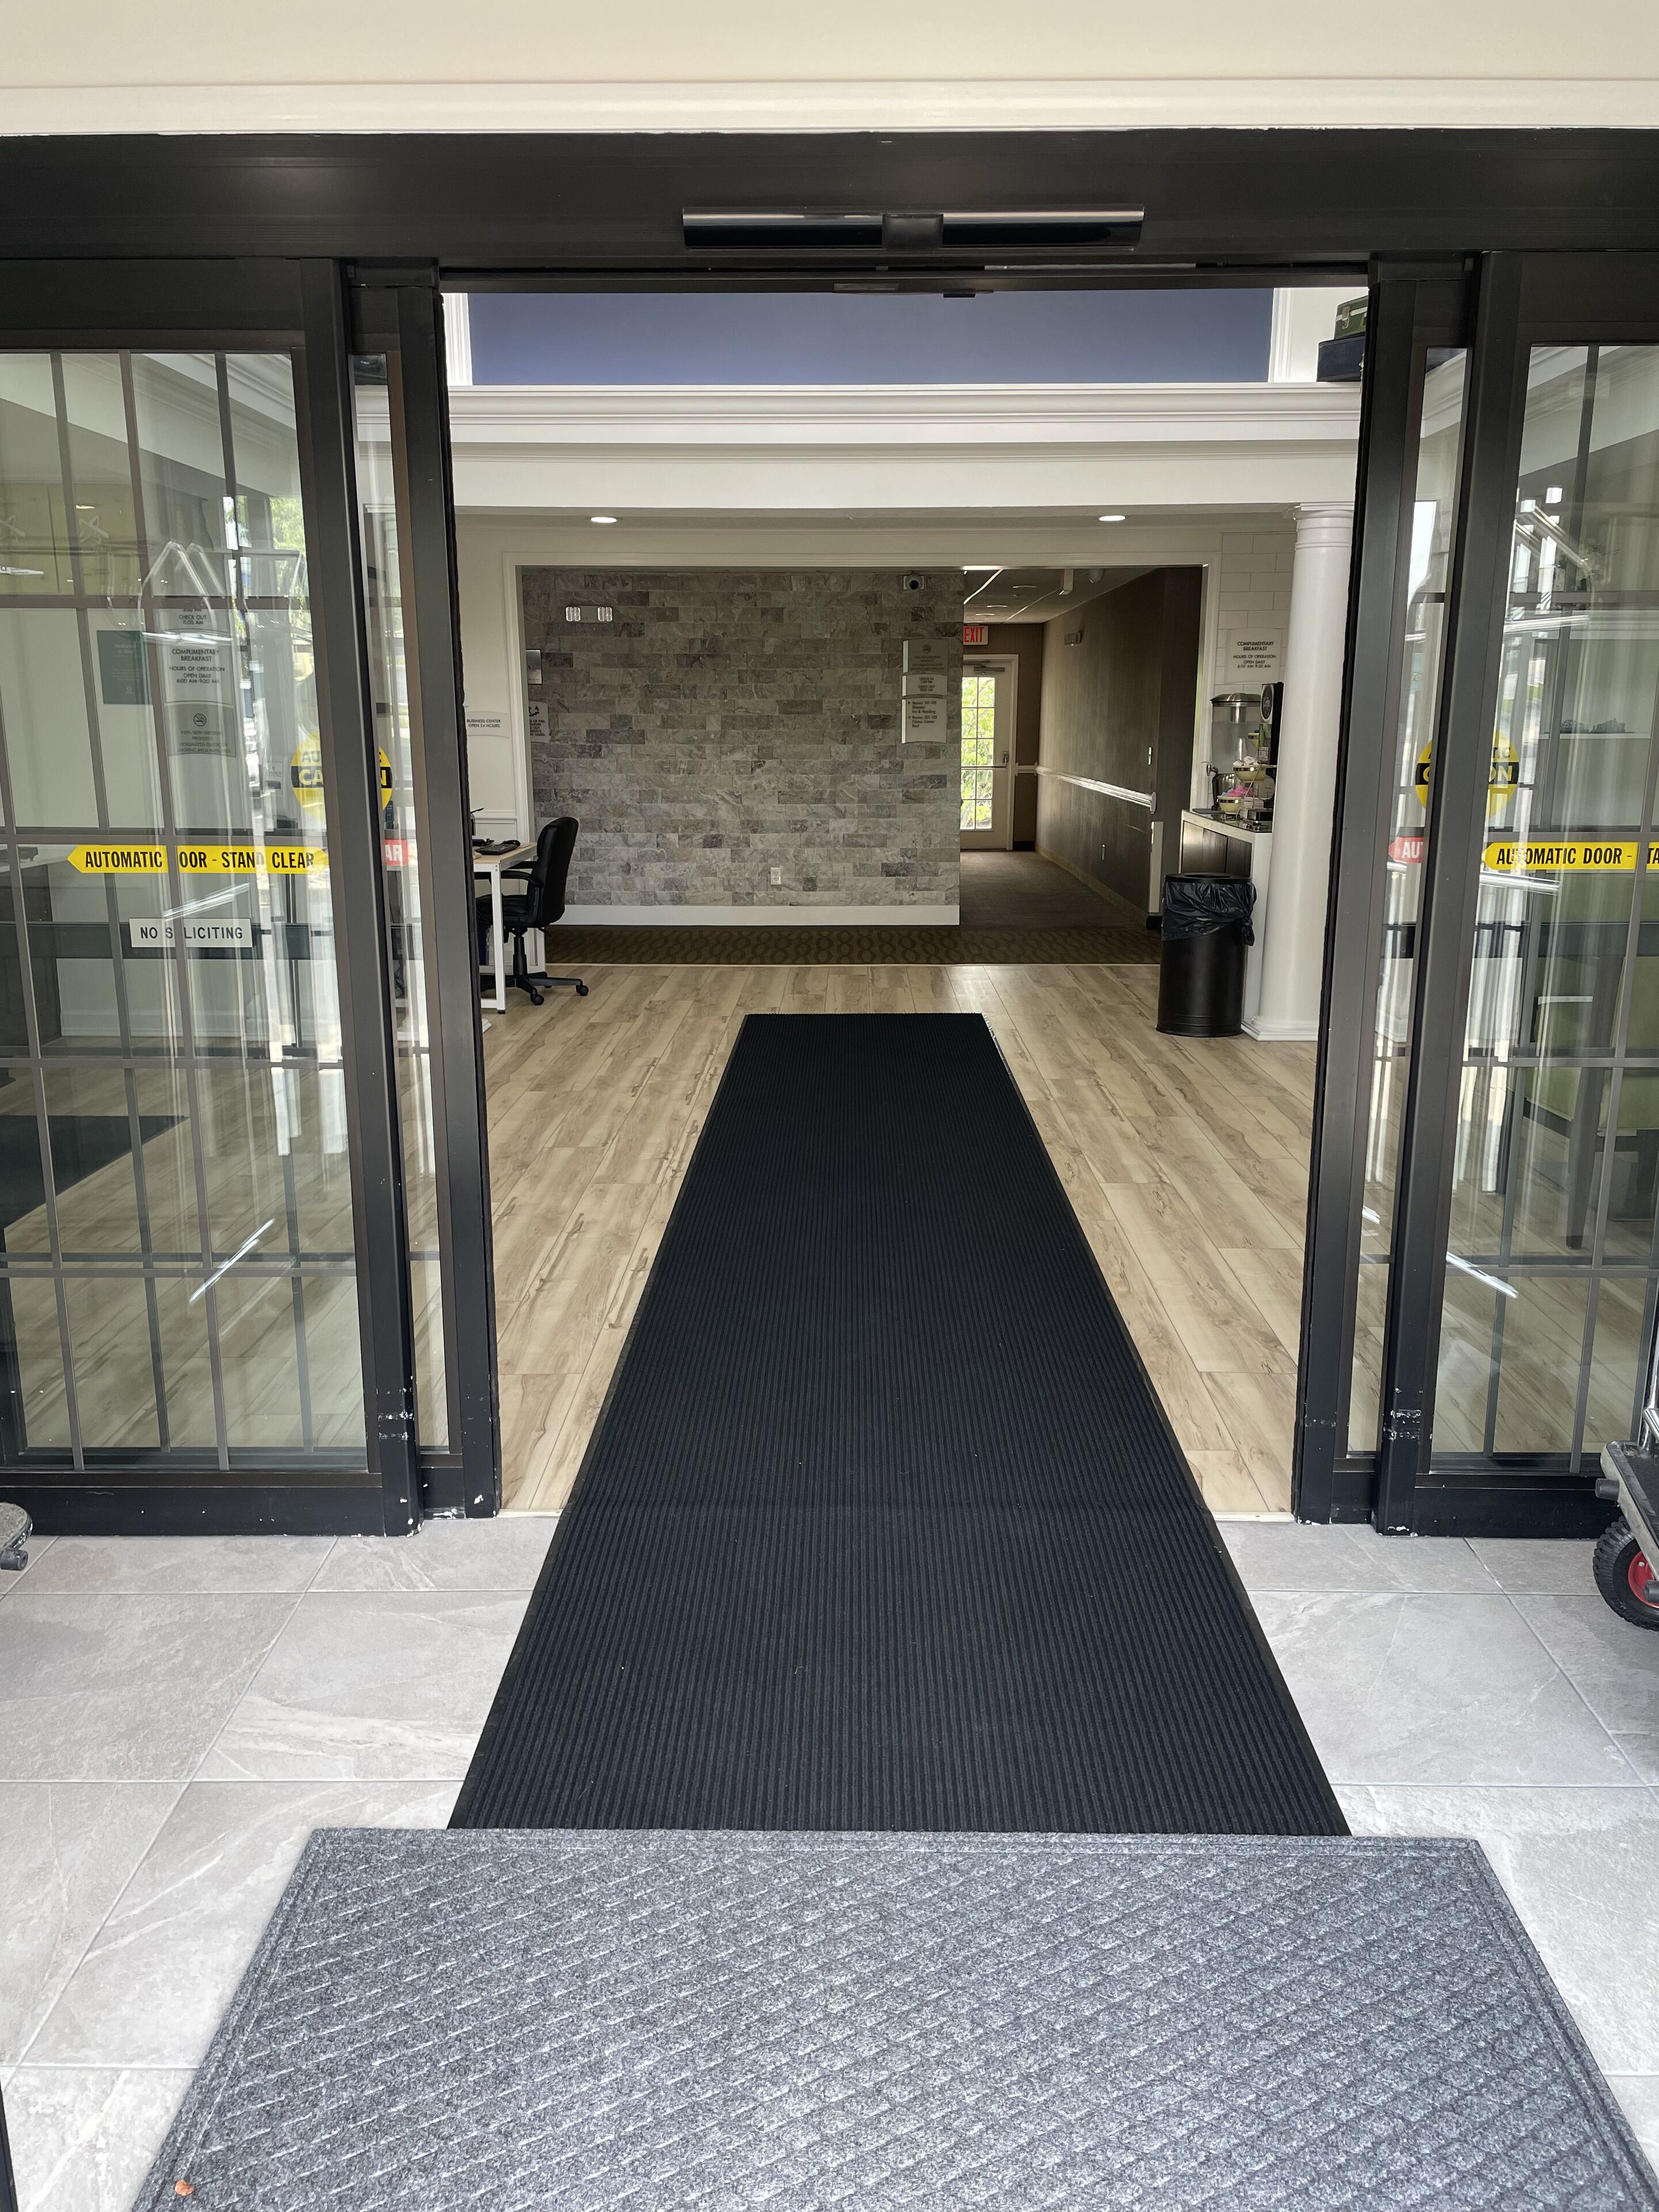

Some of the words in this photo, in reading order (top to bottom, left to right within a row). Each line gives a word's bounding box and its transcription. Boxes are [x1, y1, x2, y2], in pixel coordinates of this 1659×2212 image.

[964, 627, 984, 642] EXIT
[85, 851, 163, 868] AUTOMATIC
[179, 851, 207, 868] OOR
[221, 851, 264, 868] STAND
[272, 852, 315, 869] CLEAR
[1583, 848, 1622, 864] DOOR
[141, 927, 158, 938] NO
[165, 927, 243, 938] SLICITING
